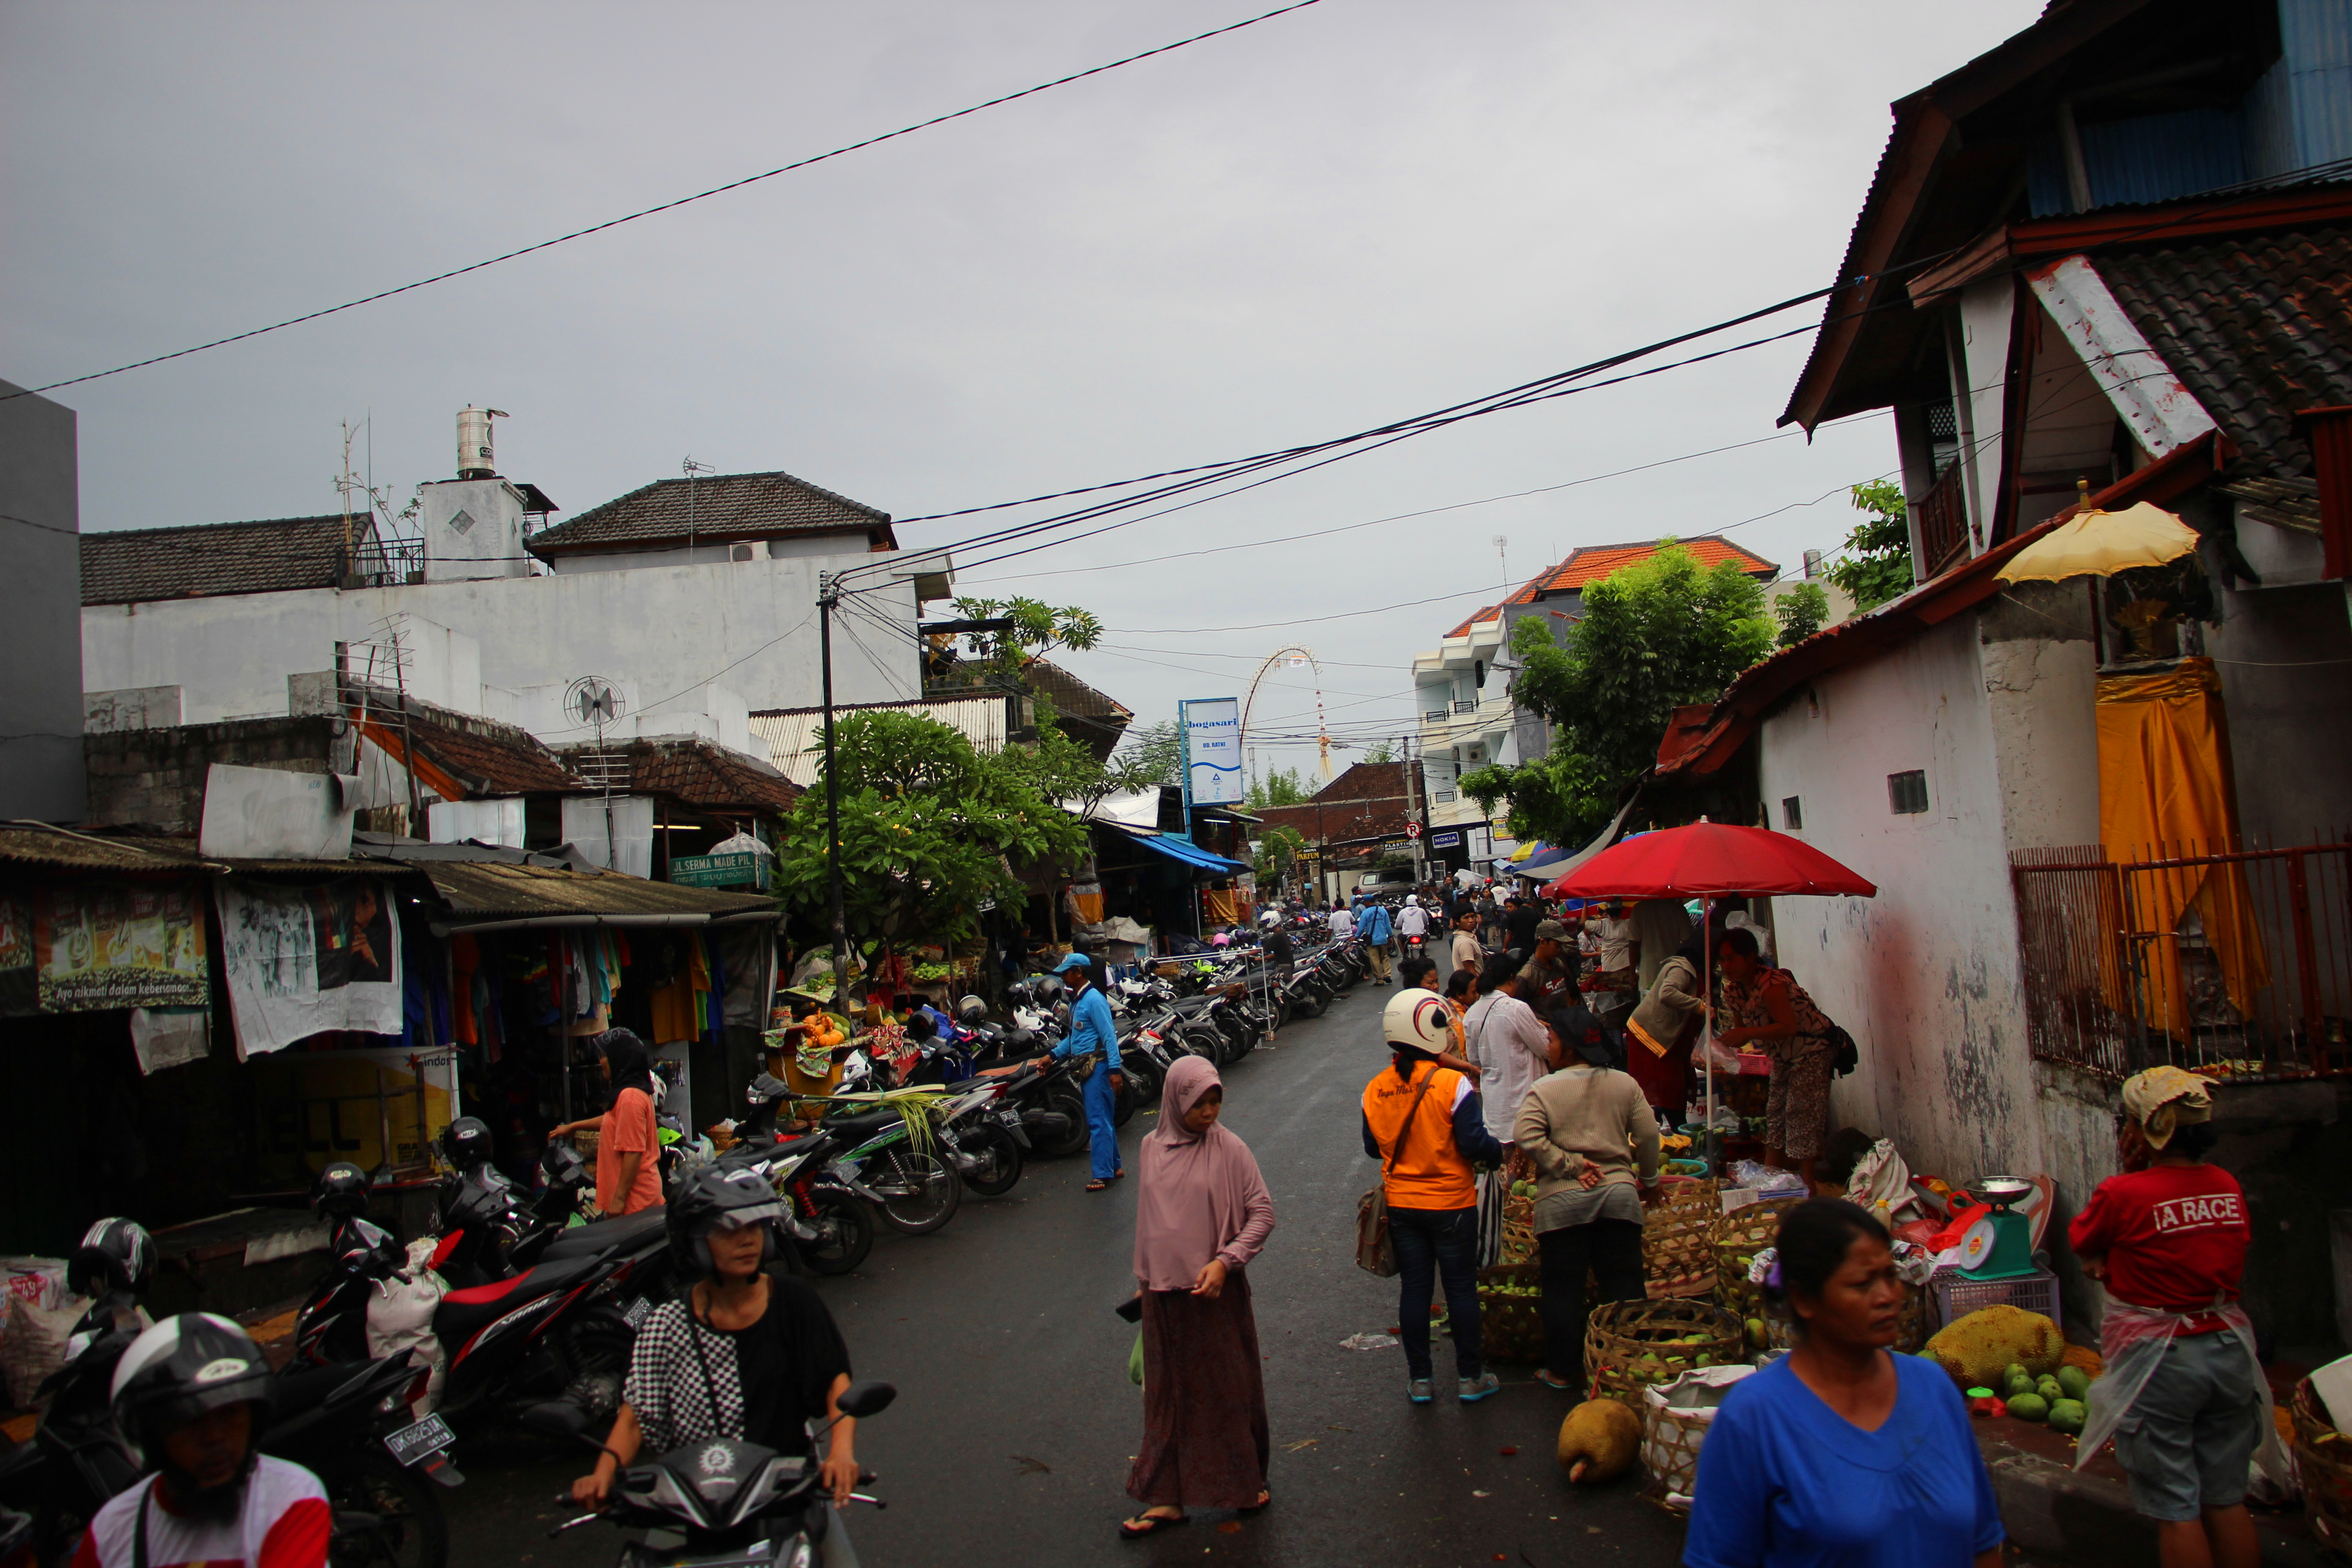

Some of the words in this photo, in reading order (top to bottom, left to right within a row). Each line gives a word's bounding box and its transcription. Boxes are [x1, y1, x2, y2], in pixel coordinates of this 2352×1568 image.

[1189, 718, 1237, 730] bogasari
[714, 856, 736, 868] MADE
[738, 854, 750, 865] PIL
[1296, 852, 1319, 860] PARFUM
[57, 987, 73, 1001] Ayo
[74, 984, 107, 998] nikmati
[109, 983, 136, 996] dalam
[2162, 1205, 2180, 1228] A
[2181, 1198, 2239, 1222] RACE
[22, 1281, 35, 1297] 49
